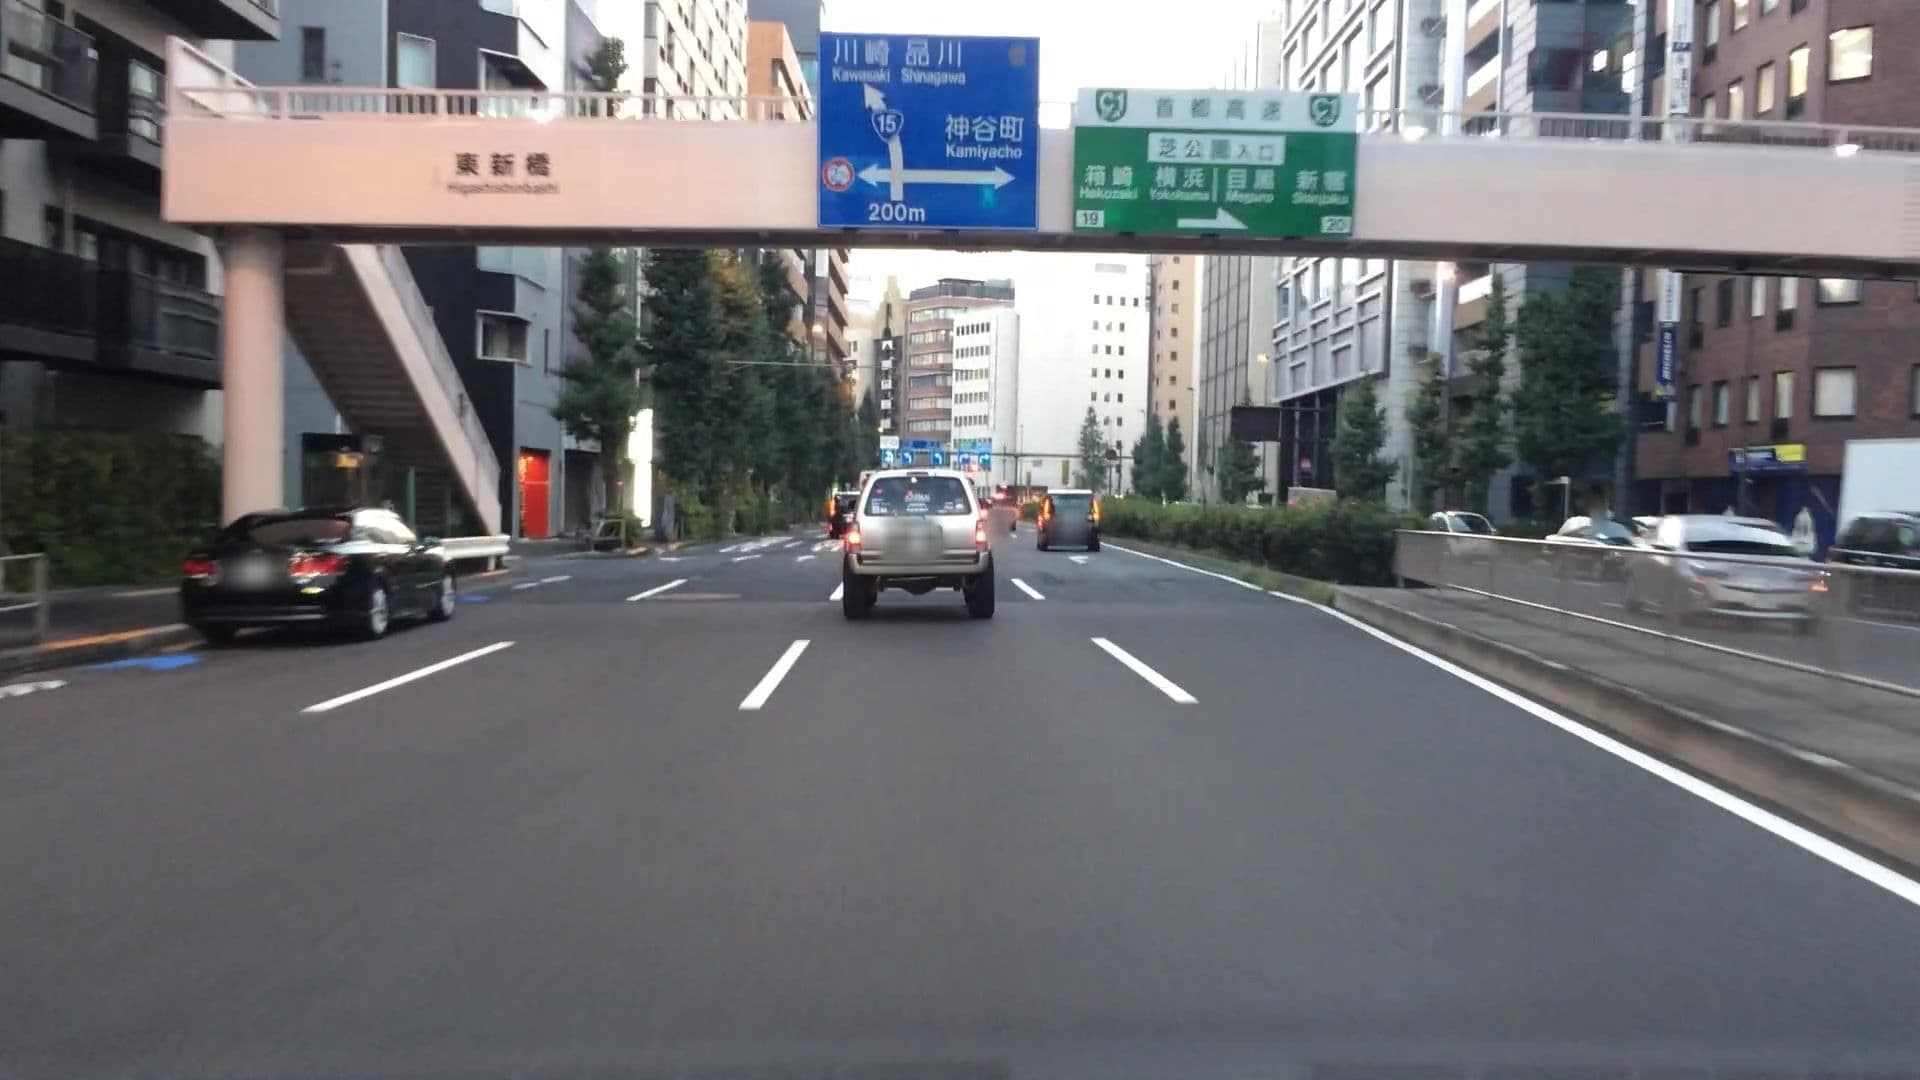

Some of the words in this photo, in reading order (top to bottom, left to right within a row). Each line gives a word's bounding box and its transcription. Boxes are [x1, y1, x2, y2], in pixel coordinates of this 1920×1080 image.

[833, 39, 890, 66] 川崎
[905, 39, 962, 67] 品川
[832, 67, 890, 83] Kawasaki
[901, 69, 966, 86] Shinagawa
[878, 115, 897, 132] 15
[944, 114, 1025, 143] 神谷町
[945, 144, 1023, 161] Kamiyacho
[455, 152, 551, 177] 東新橋
[1155, 166, 1205, 189] 横浜
[868, 203, 925, 222] 200m
[1081, 211, 1099, 226] 19
[1326, 217, 1346, 232] 20
